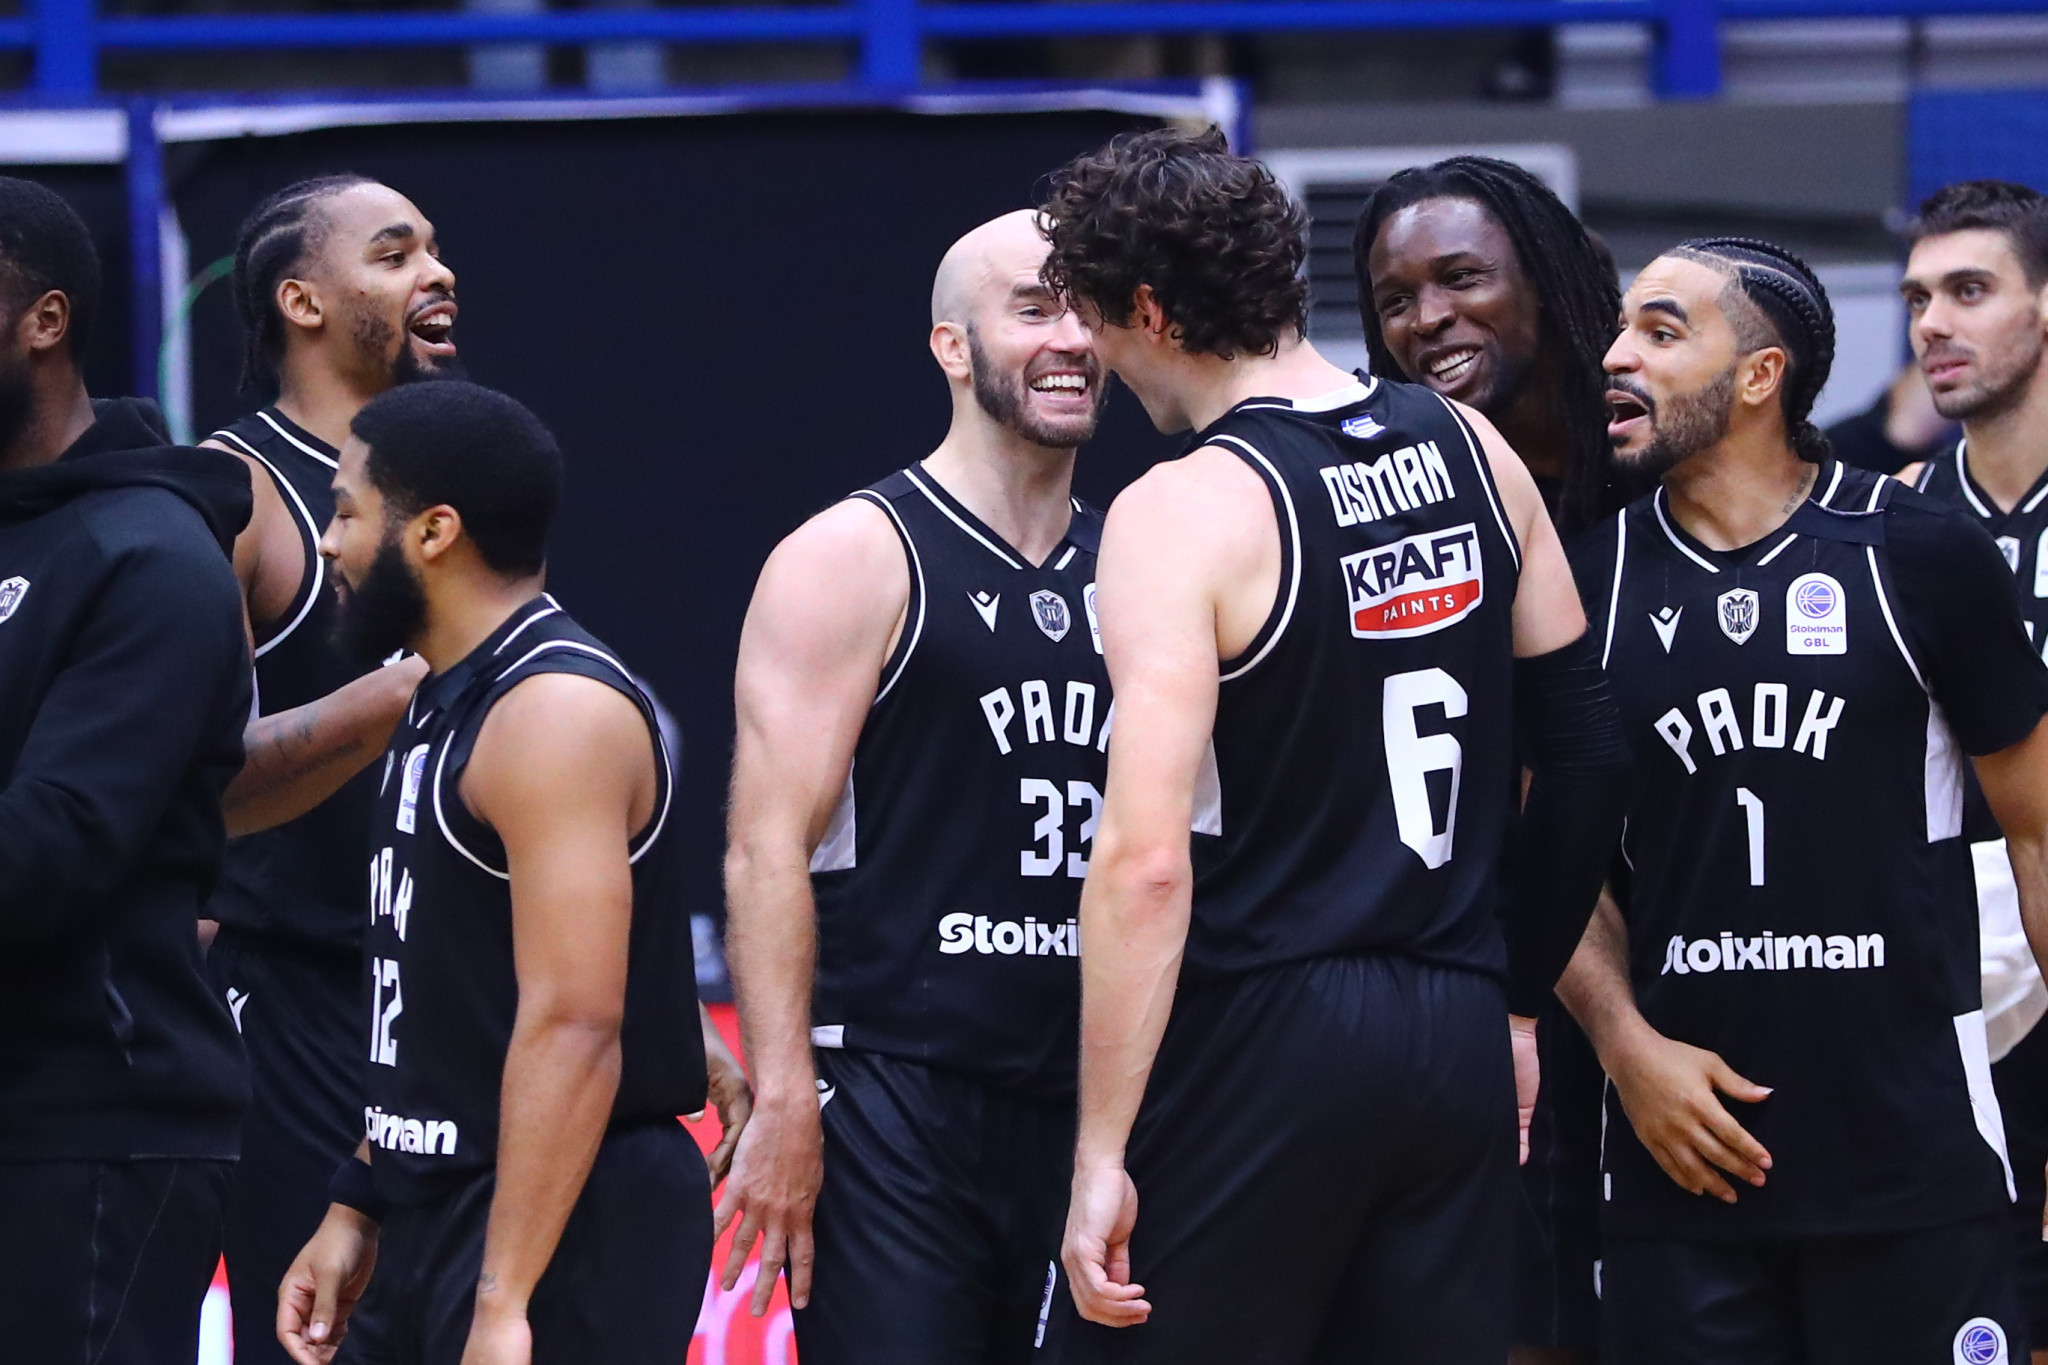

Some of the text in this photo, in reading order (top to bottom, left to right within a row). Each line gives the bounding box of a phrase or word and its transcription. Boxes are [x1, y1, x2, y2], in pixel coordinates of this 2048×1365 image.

[1319, 440, 1456, 528] OSMAN
[1346, 530, 1475, 603] KRAFT
[1383, 593, 1455, 623] PAINTS
[1790, 624, 1844, 633] Stoiximan
[1803, 637, 1830, 648] GBL
[1382, 667, 1469, 870] 6
[1653, 682, 1846, 775] PAOK
[1020, 777, 1104, 879] 33
[1736, 787, 1765, 886] 1
[370, 847, 414, 942] PAK
[938, 912, 1082, 957] Stoixi
[369, 956, 403, 1068] 12
